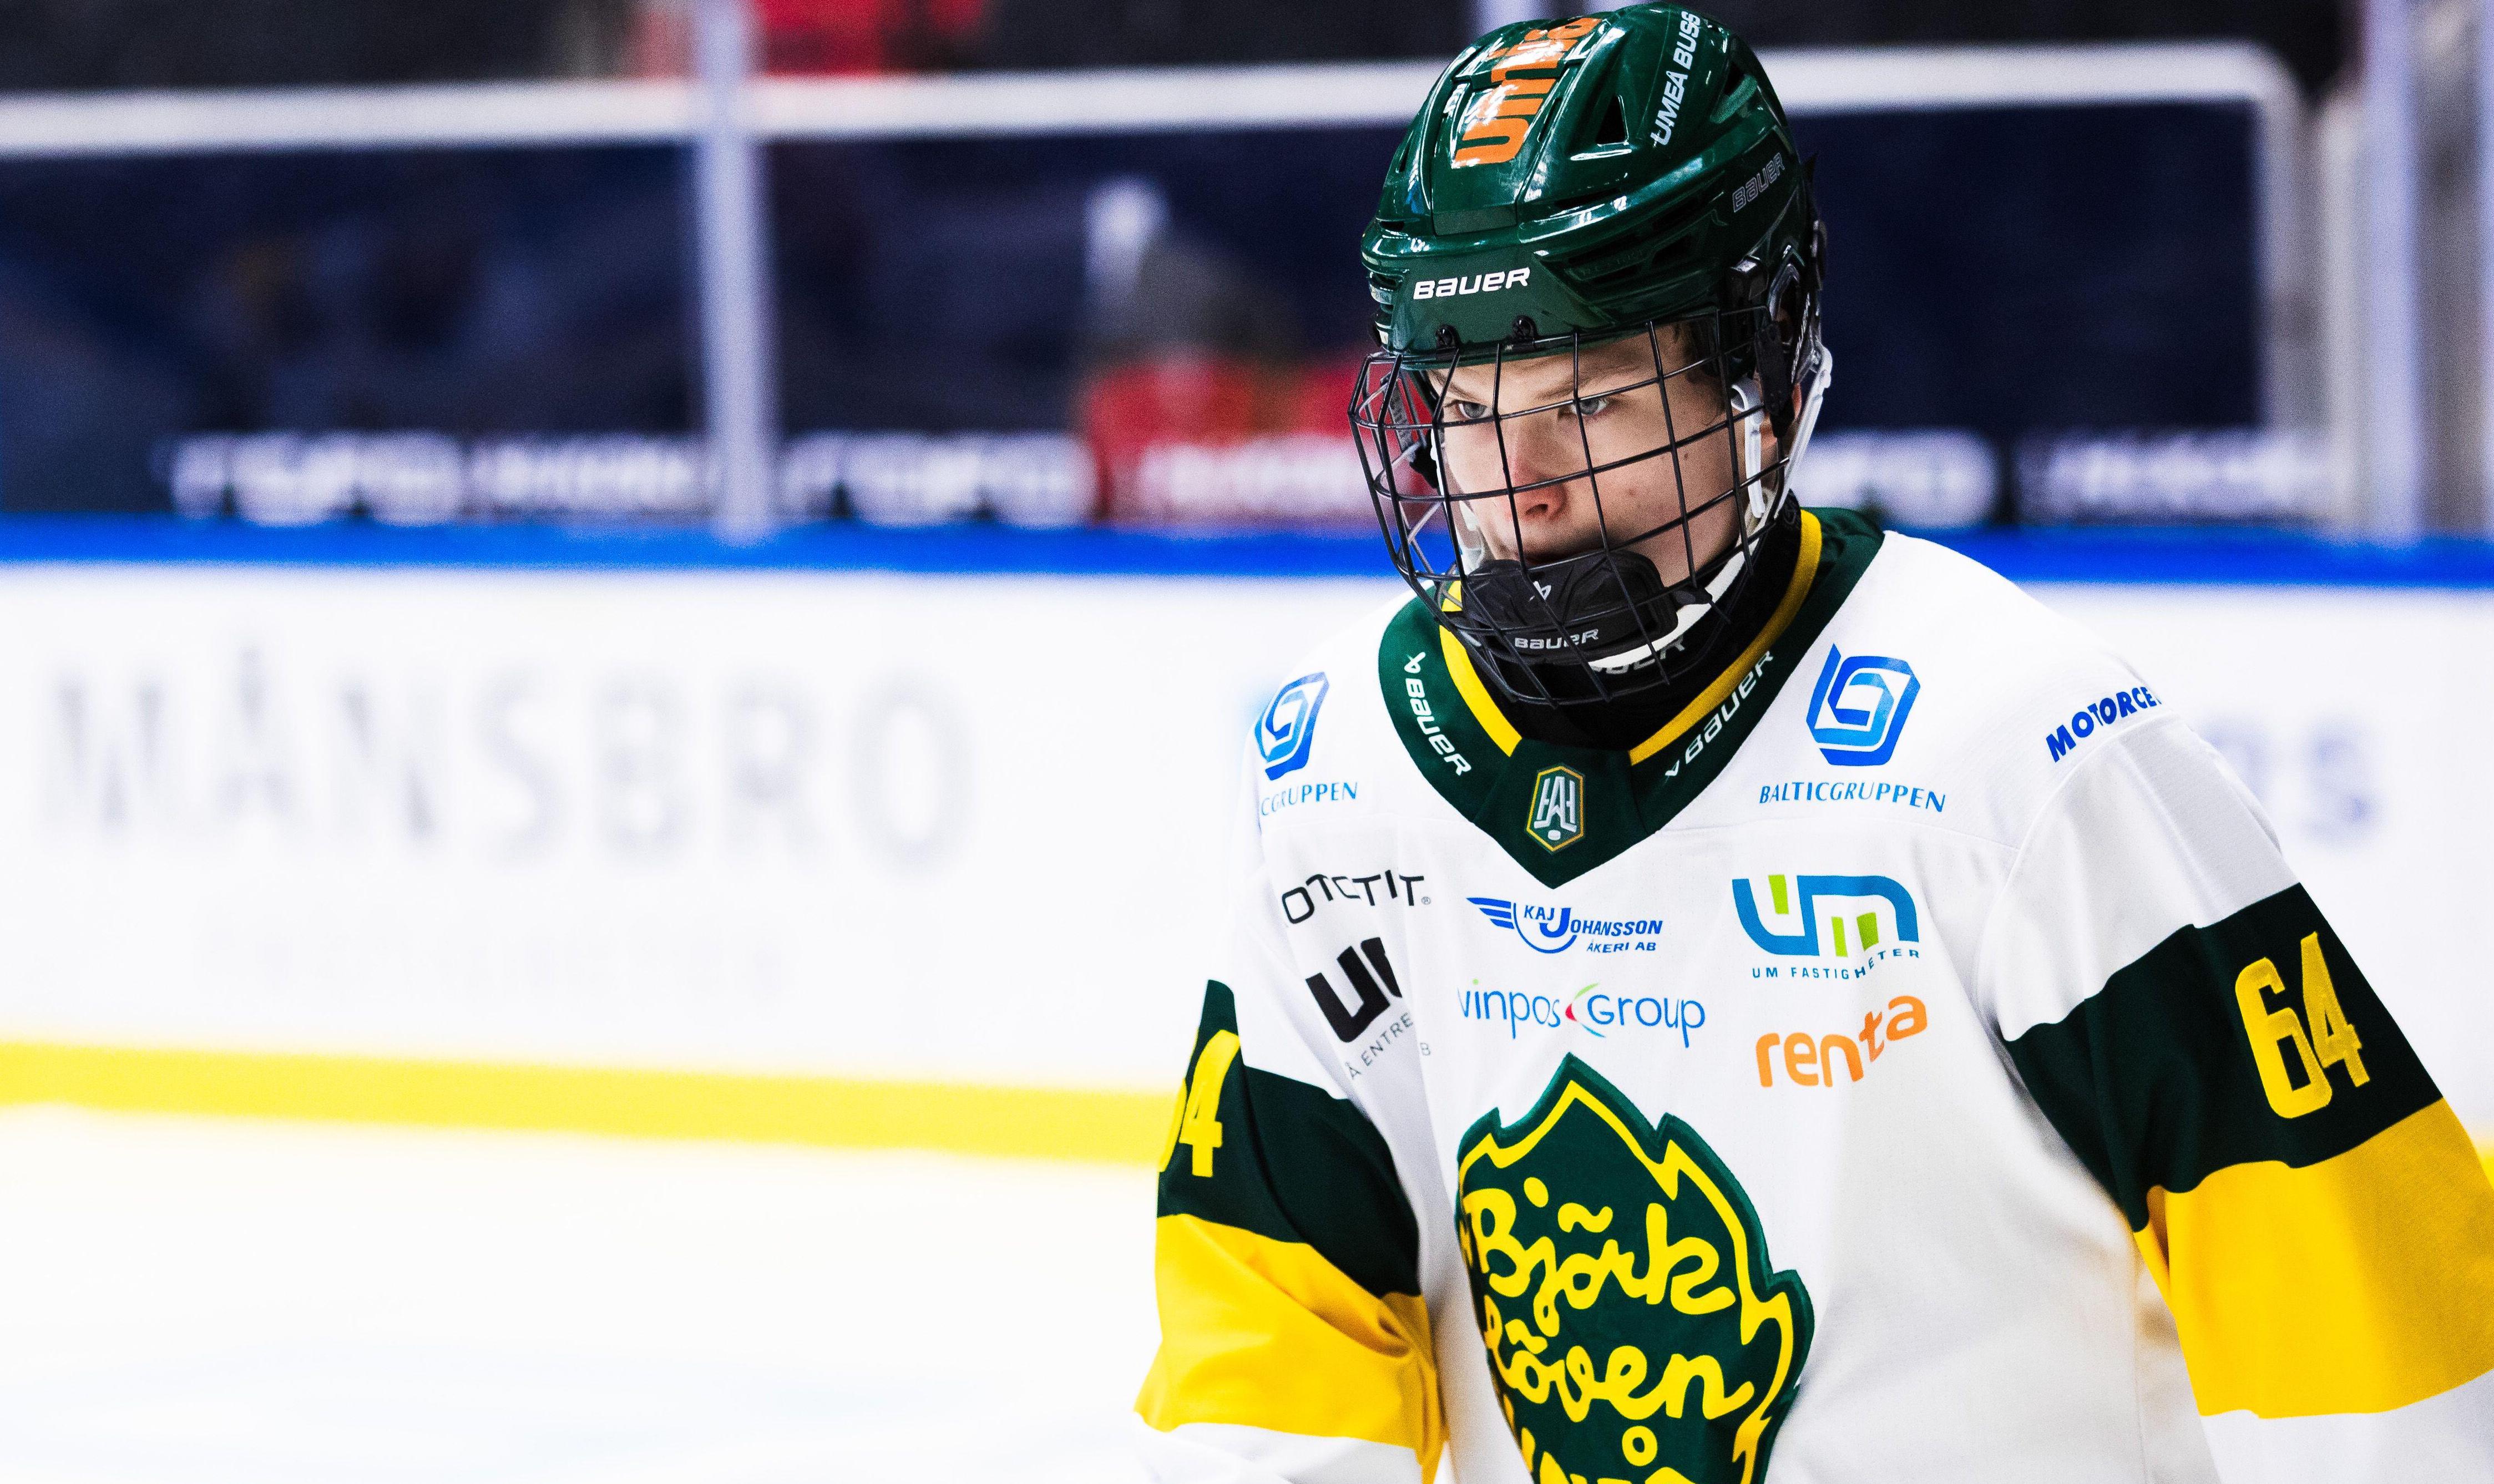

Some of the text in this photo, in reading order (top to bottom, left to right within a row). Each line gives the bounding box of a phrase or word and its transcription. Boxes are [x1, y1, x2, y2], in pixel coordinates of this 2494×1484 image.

[1673, 11, 1701, 70] BUSS
[2046, 686, 2162, 763] MOTORCE
[1261, 782, 1358, 816] CGRUPPEN
[1759, 781, 1946, 813] BALTICGRUPPEN
[1524, 905, 1555, 921] KAJ
[1587, 940, 1657, 953] ÅKERI AB
[1752, 948, 1920, 980] UM FASTIGHETER
[1360, 1012, 1414, 1067] ENTRE
[1756, 995, 1928, 1088] renta
[2235, 931, 2370, 1119] 64
[1159, 1030, 1241, 1178] 4
